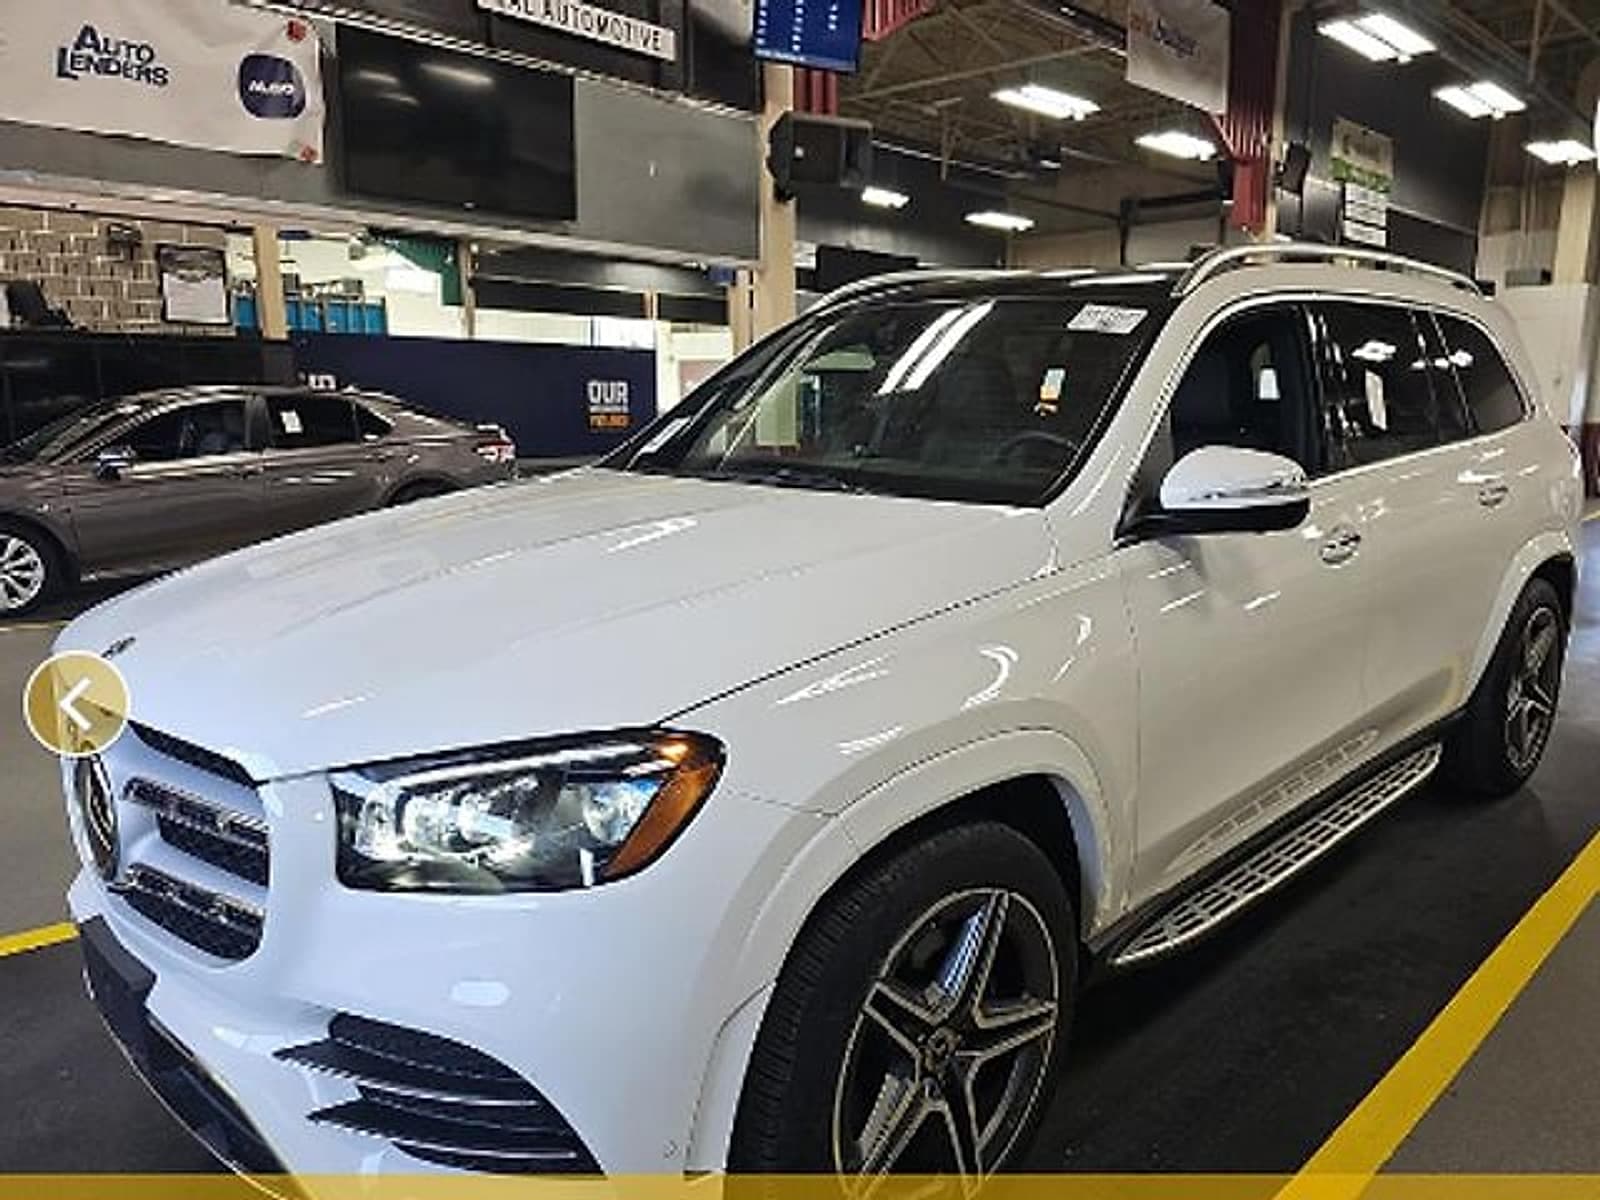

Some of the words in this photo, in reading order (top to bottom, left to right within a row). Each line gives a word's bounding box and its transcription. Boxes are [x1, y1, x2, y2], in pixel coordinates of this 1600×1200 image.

[74, 24, 155, 66] AUTO
[540, 1, 662, 52] AUTOMOTIVE
[58, 48, 168, 86] LENDERS
[588, 380, 629, 404] OUR
